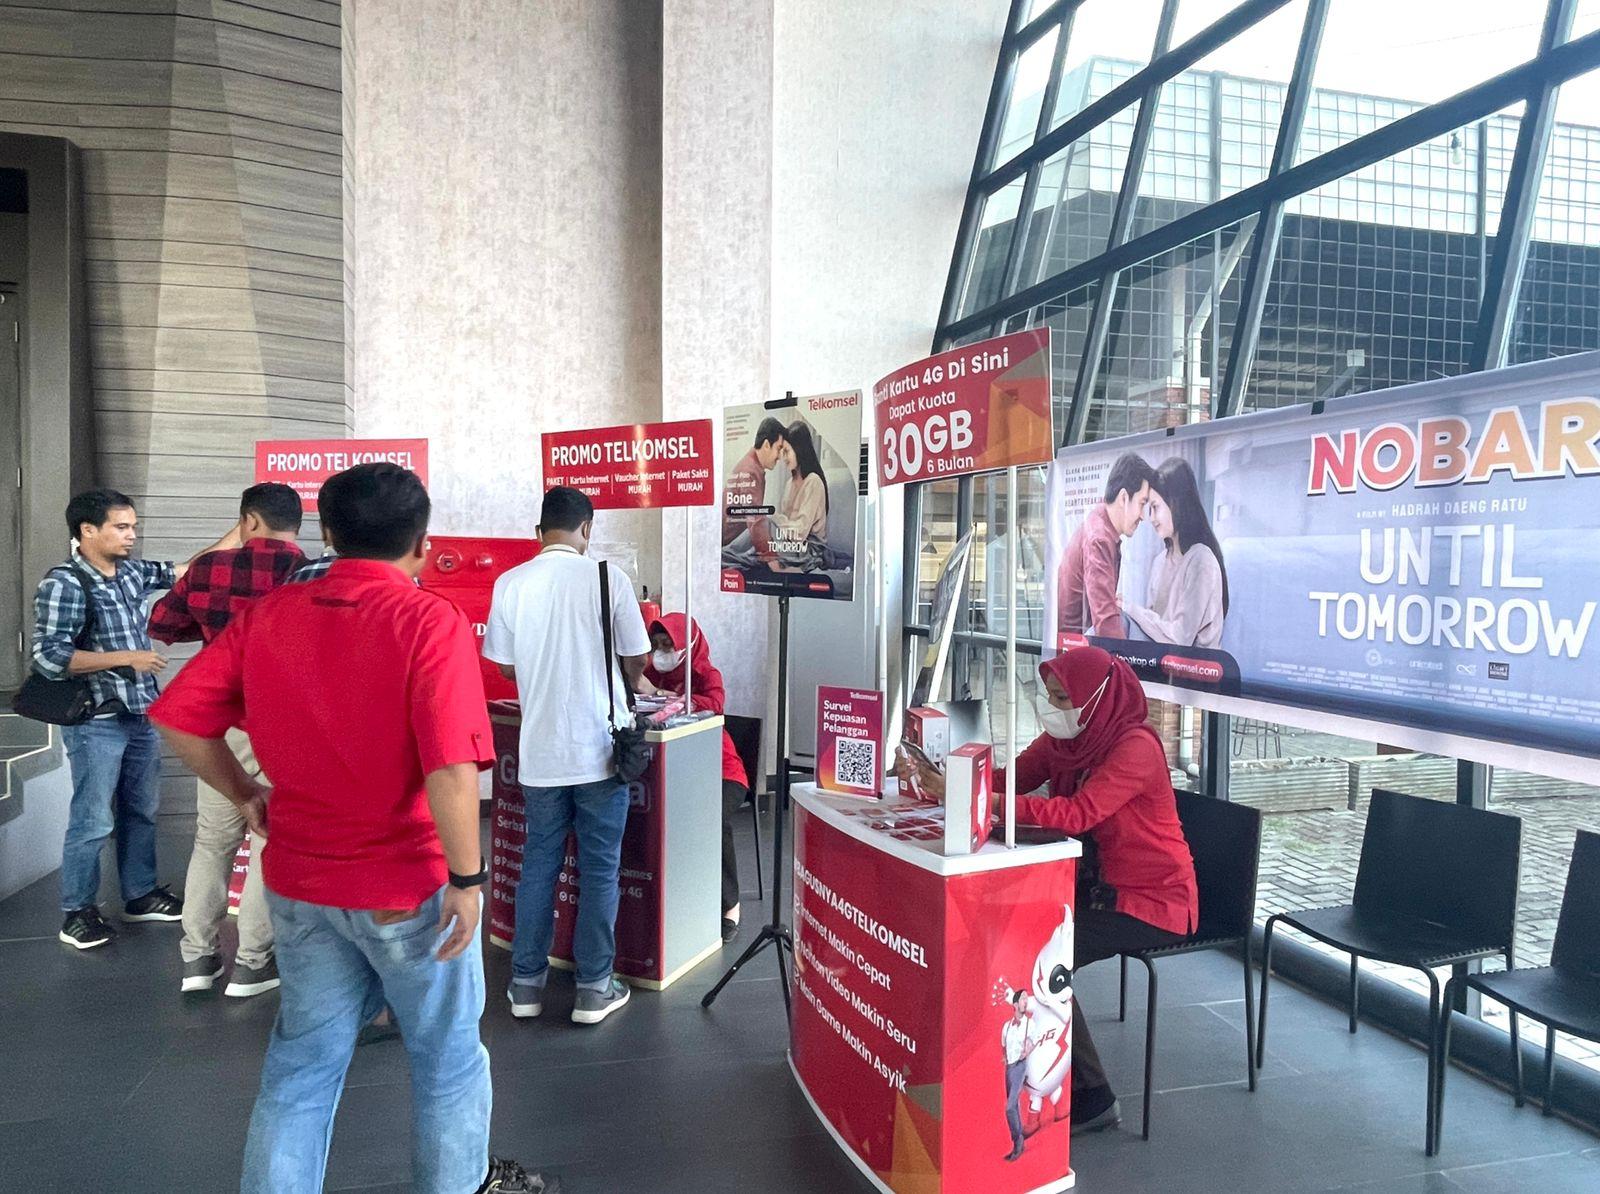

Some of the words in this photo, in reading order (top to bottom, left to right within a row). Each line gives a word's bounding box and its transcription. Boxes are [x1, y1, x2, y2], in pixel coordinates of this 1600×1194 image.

[890, 375, 919, 397] Kartu
[922, 365, 943, 386] 4G
[948, 357, 966, 380] Di
[971, 347, 1009, 374] Sini
[808, 393, 858, 411] Telkomsel
[889, 402, 916, 421] Dapat
[918, 391, 956, 411] Kuota
[551, 443, 601, 467] PROMO
[604, 436, 699, 463] TELKOMSEL
[1307, 397, 1600, 496] NOBAR
[267, 453, 321, 472] PROMO
[927, 459, 934, 473] 6
[937, 455, 974, 472] Bulan
[546, 476, 564, 485] PAKET
[570, 476, 585, 485] Kartu
[585, 474, 609, 484] Internet
[672, 469, 690, 479] Paket
[628, 484, 652, 494] MURAH
[678, 482, 703, 492] MURAH
[726, 491, 753, 504] Bone
[1392, 502, 1440, 517] HADRAH
[1444, 499, 1487, 514] DAENG
[1491, 497, 1528, 513] RATU
[776, 527, 801, 540] UNTIL
[768, 540, 809, 553] TOMORROW
[1360, 523, 1543, 589] UNTIL
[1309, 591, 1598, 659] TOMORROW
[850, 691, 878, 701] Telkomsel
[823, 700, 852, 712] Survei
[823, 711, 867, 725] Kepuasan
[823, 722, 869, 737] Pelanggan
[801, 902, 827, 940] Internet
[828, 930, 856, 964] Makin
[857, 953, 891, 991] Cepat
[825, 965, 851, 1001] Video
[852, 992, 884, 1032] Makin
[886, 1019, 917, 1055] Seru
[800, 978, 816, 1007] Main
[816, 999, 841, 1034] Game
[842, 1023, 872, 1064] Makin
[874, 1055, 907, 1094] Asyik
